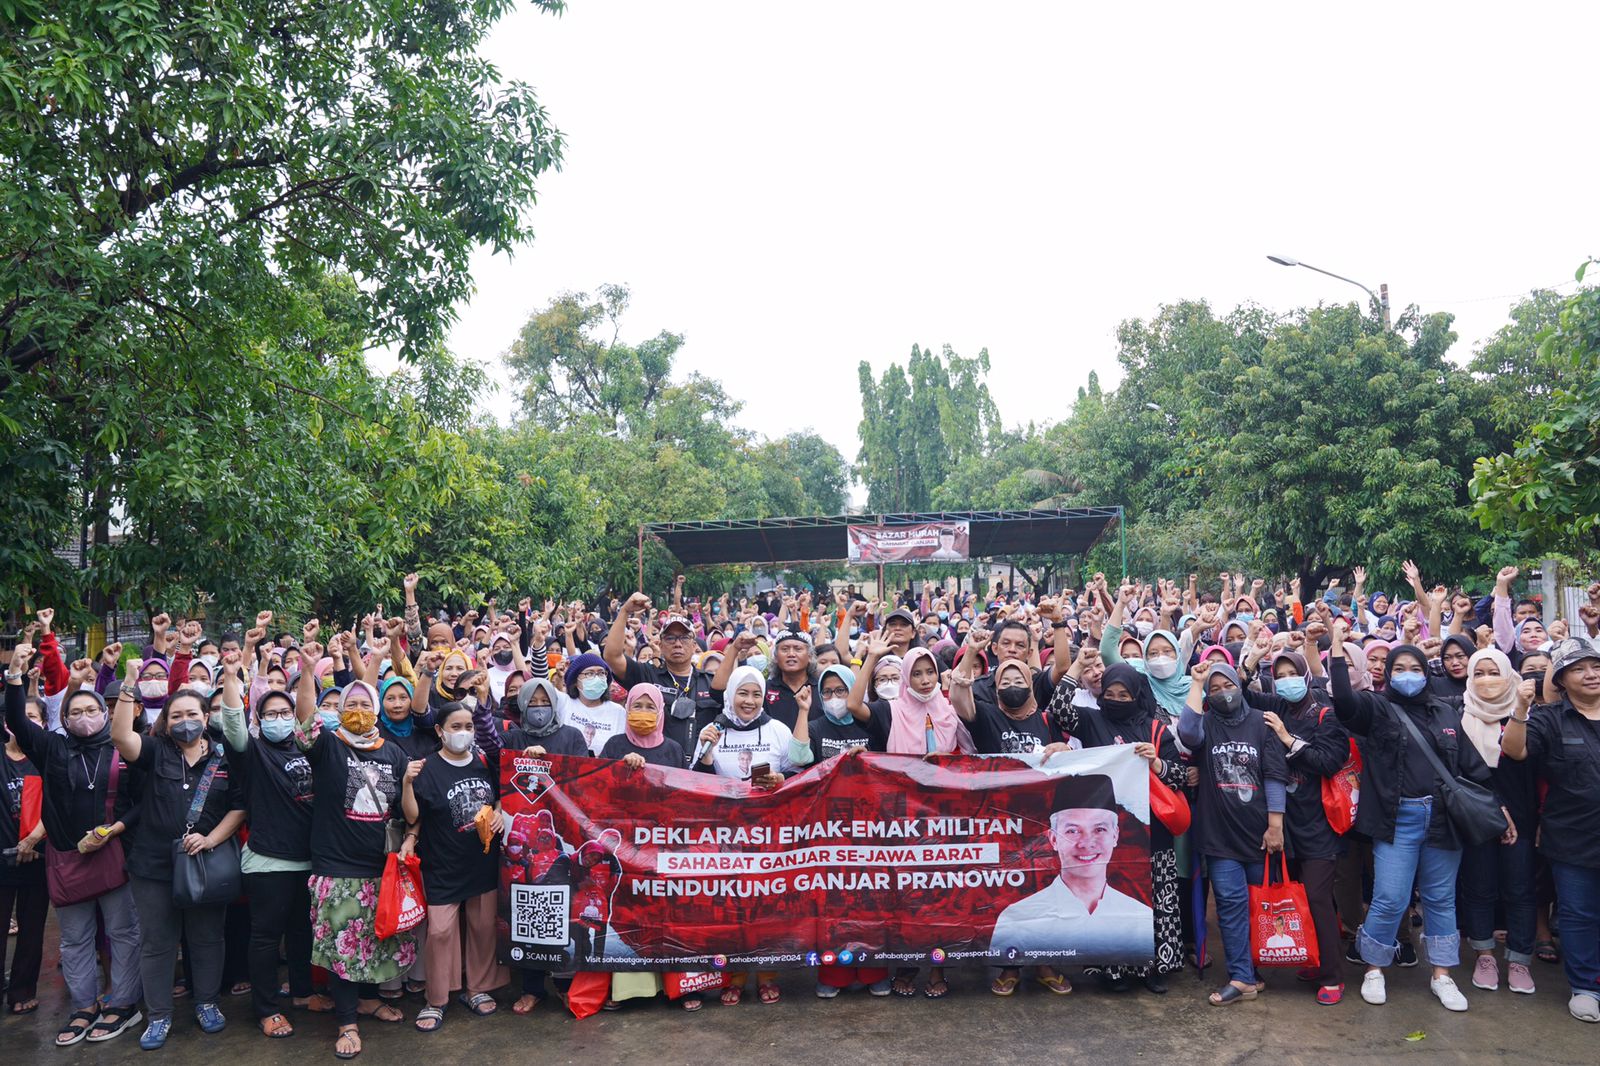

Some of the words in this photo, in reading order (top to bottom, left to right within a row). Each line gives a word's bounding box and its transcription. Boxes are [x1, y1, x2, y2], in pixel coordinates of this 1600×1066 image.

[876, 530, 906, 539] BAZAR
[1211, 743, 1257, 757] GANJAR
[513, 757, 552, 768] SAHABAT
[516, 764, 550, 774] GANJAR
[634, 826, 772, 845] DEKLARASI
[778, 820, 920, 844] EMAK-EMAK
[927, 818, 1023, 837] MILITAN
[667, 856, 754, 870] SAHABAT
[759, 850, 831, 869] GANJAR
[835, 849, 917, 862] SE-JAWA
[922, 847, 983, 862] BARAT
[631, 877, 787, 898] MENDUKUNG
[793, 872, 891, 891] GANJAR
[897, 869, 1025, 890] PRANOWO
[525, 952, 547, 961] SCAN
[549, 954, 562, 962] ME
[874, 952, 926, 961] sahabatganjar
[948, 949, 1000, 960] sagaesports.id
[1024, 949, 1076, 959] sagaesportsid
[1258, 947, 1308, 957] GANJAR
[602, 956, 672, 966] sahabatganjar.com
[729, 955, 801, 964] sahabatganjar2024
[679, 972, 722, 988] GANJAR
